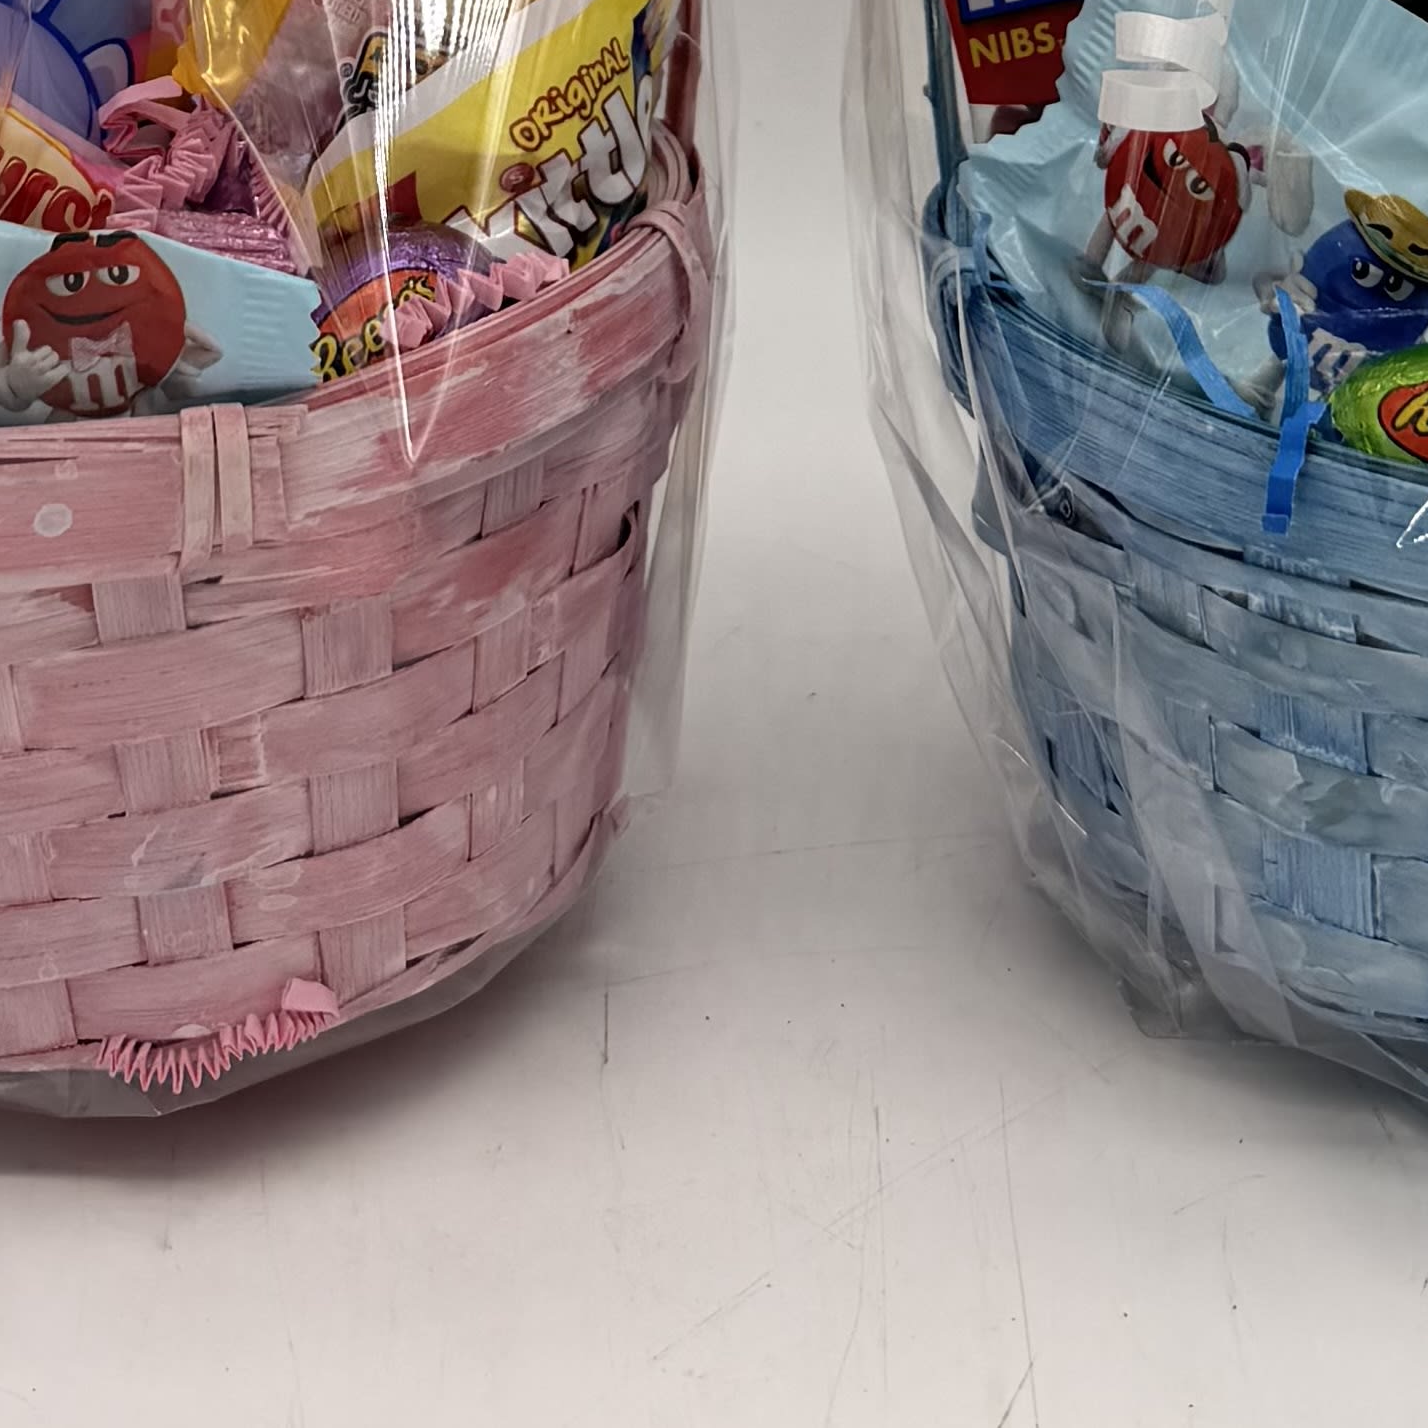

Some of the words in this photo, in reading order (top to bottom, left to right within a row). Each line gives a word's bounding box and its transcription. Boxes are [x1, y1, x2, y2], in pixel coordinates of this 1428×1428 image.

[969, 21, 1056, 69] NIBS
[443, 74, 654, 266] kittl
[309, 277, 436, 382] Ree's
